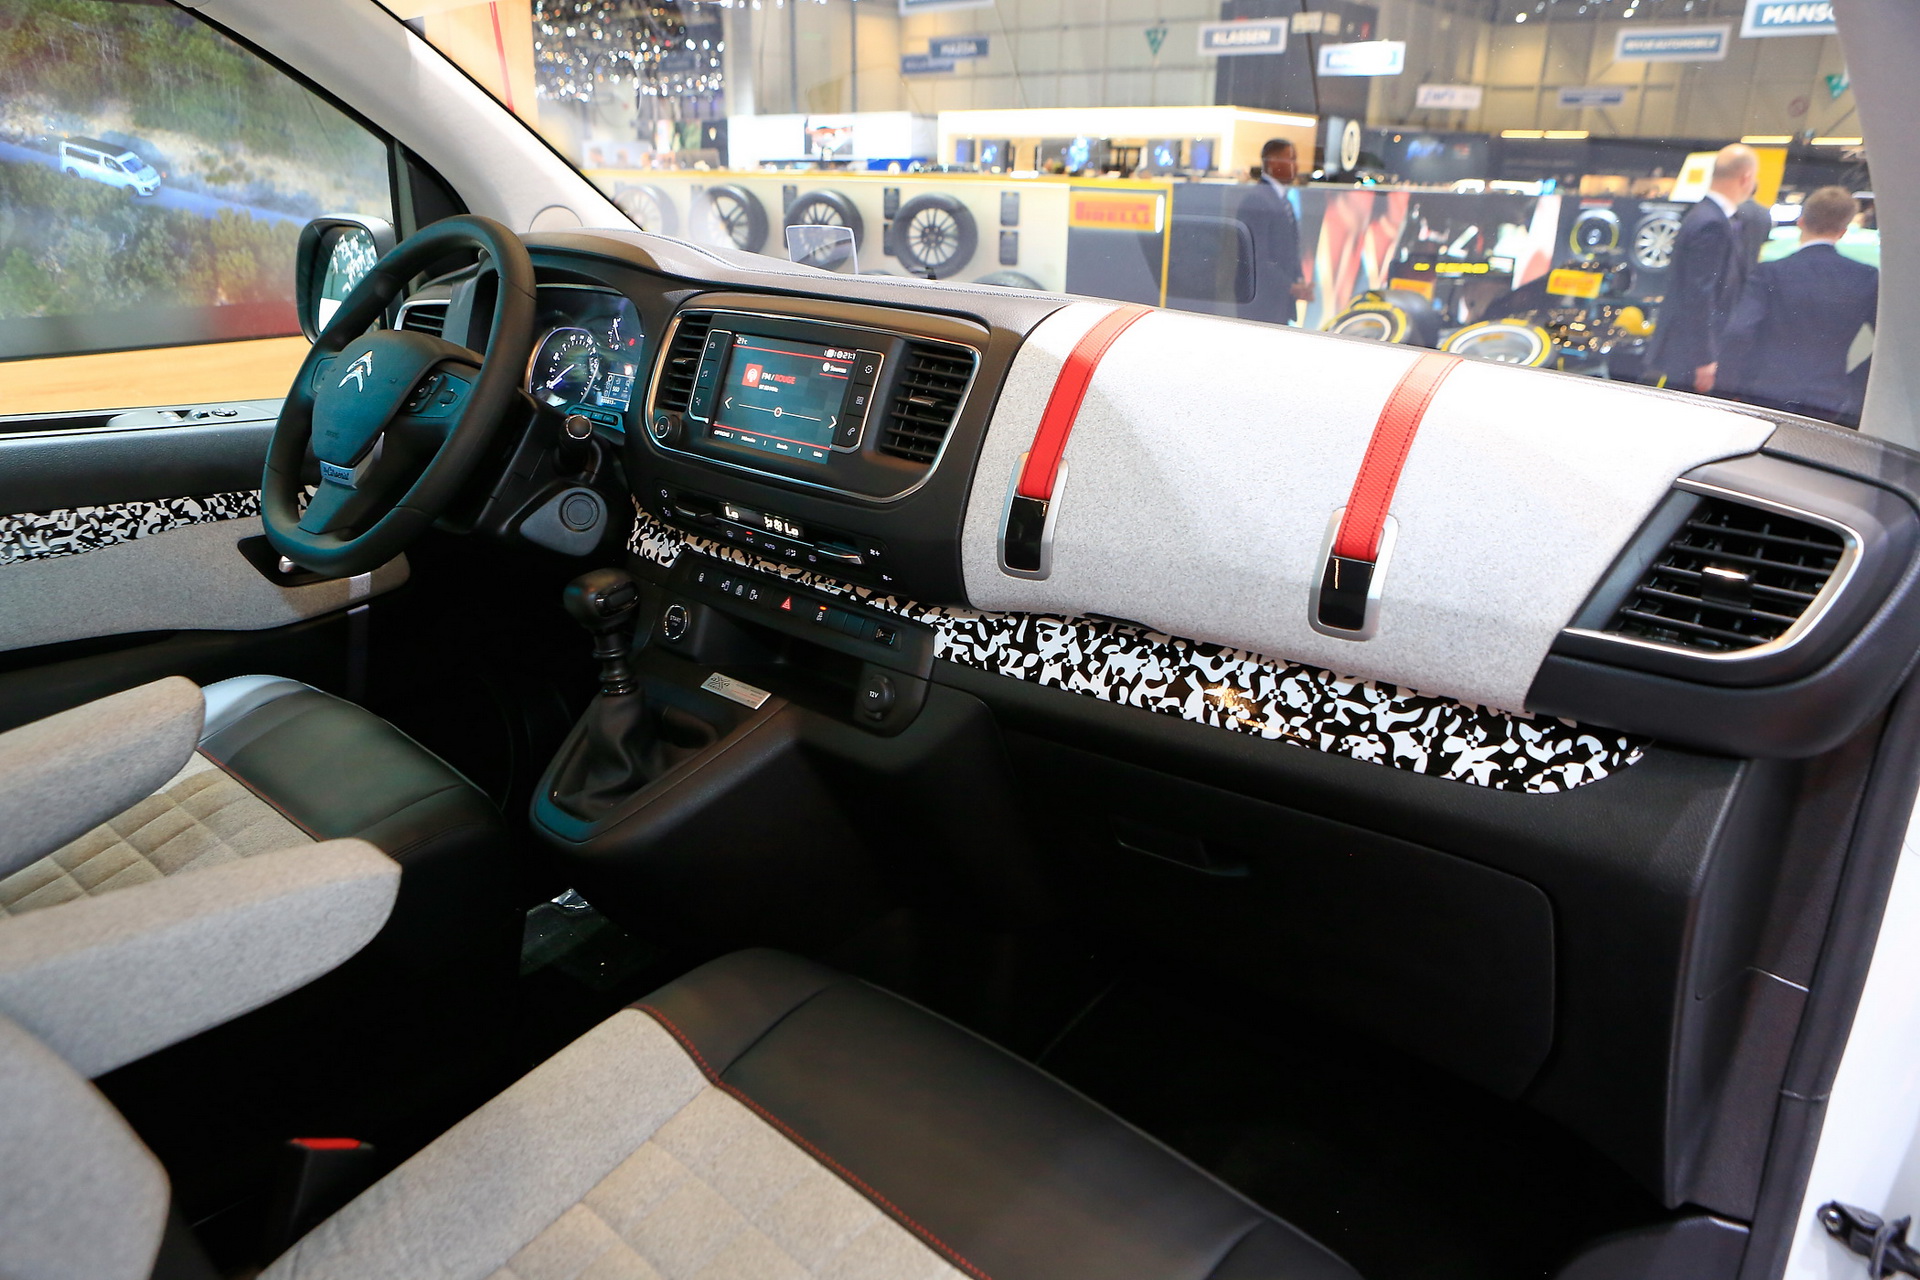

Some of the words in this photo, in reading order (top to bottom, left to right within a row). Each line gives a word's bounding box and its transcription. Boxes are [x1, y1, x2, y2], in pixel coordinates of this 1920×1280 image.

[1211, 28, 1272, 47] KLASSEN
[1075, 201, 1151, 225] PIRELLI
[869, 690, 880, 699] 12V
